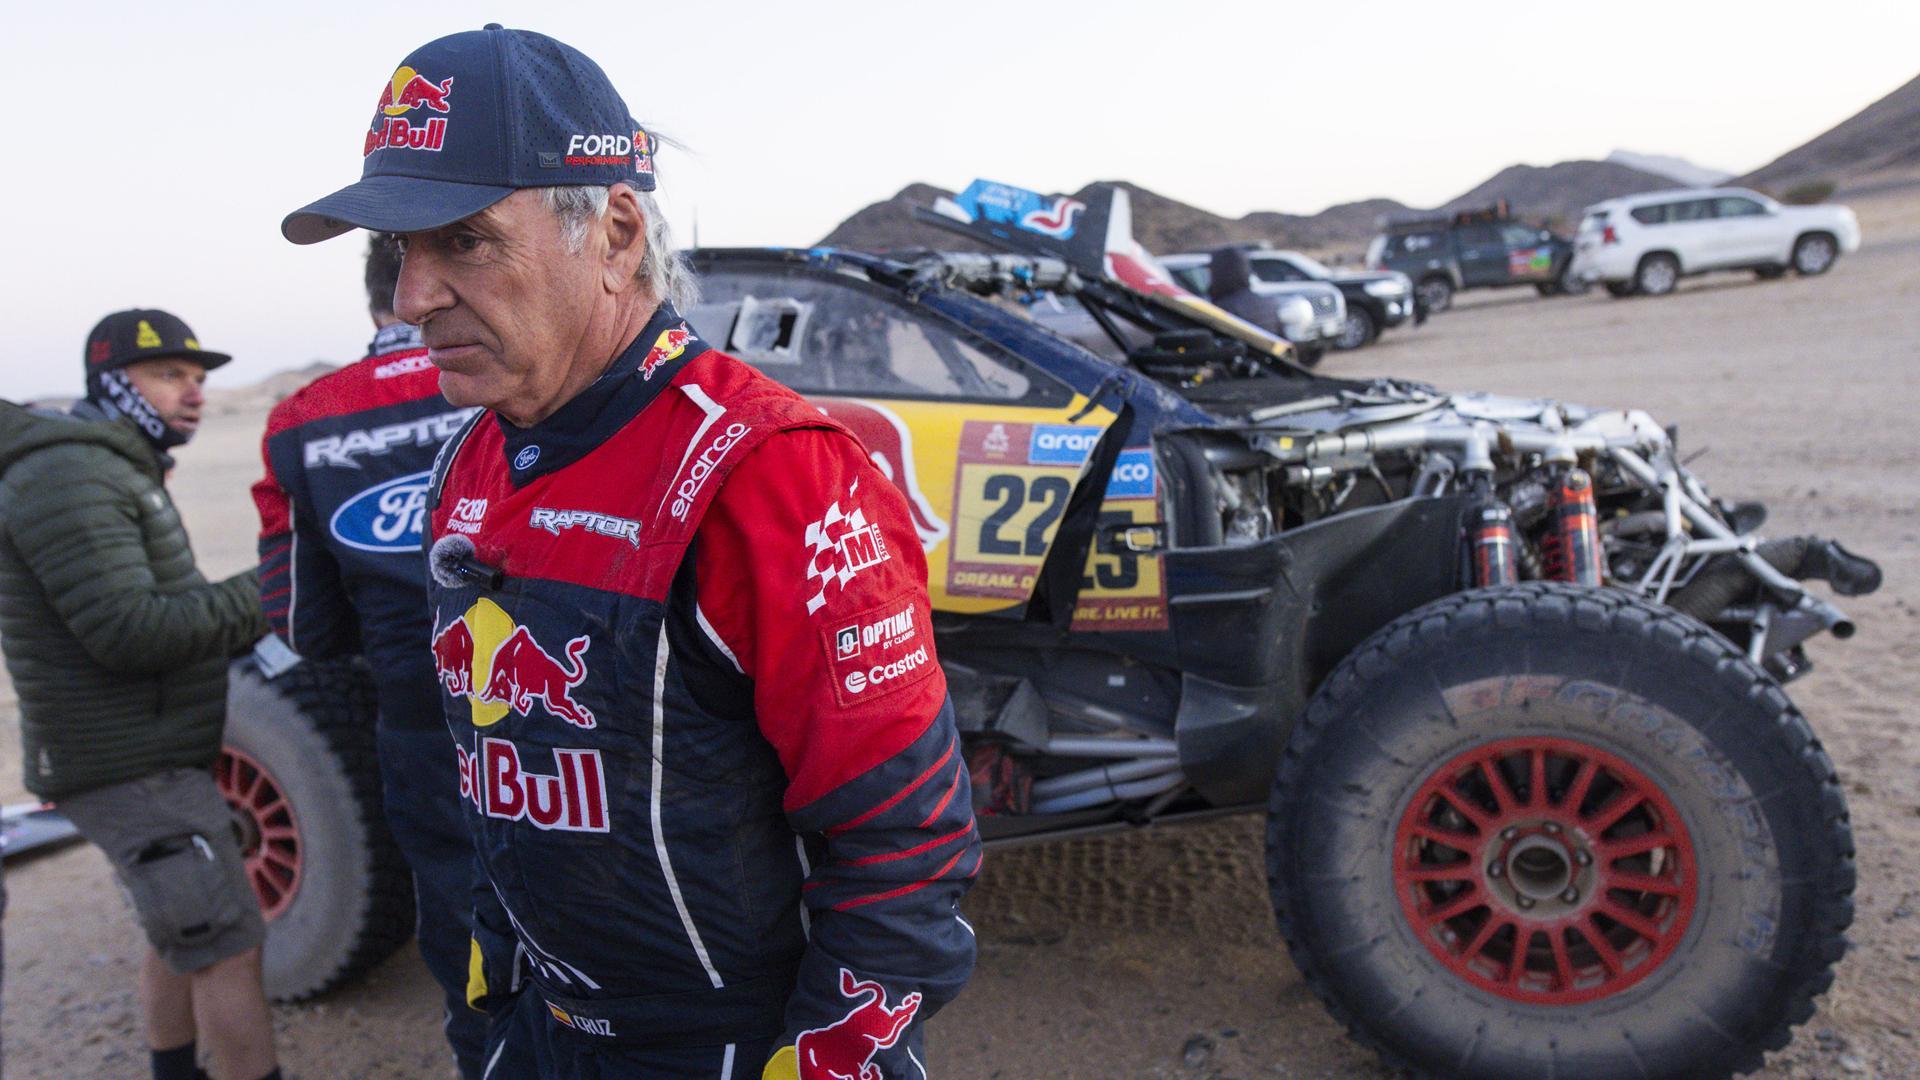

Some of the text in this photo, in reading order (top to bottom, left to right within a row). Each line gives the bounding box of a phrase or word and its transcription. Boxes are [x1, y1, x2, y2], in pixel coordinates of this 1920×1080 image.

[389, 117, 448, 151] Bull
[567, 135, 631, 155] FORD
[564, 155, 631, 166] PERFORMANCE
[304, 408, 484, 470] RAPTO
[671, 423, 749, 521] sparco
[451, 498, 488, 521] FORD
[530, 507, 642, 550] RAPTOR
[1105, 606, 1140, 620] LIVE
[868, 645, 929, 684] Castrol
[456, 731, 611, 833] ed Bull
[573, 1015, 617, 1037] CRUZ
